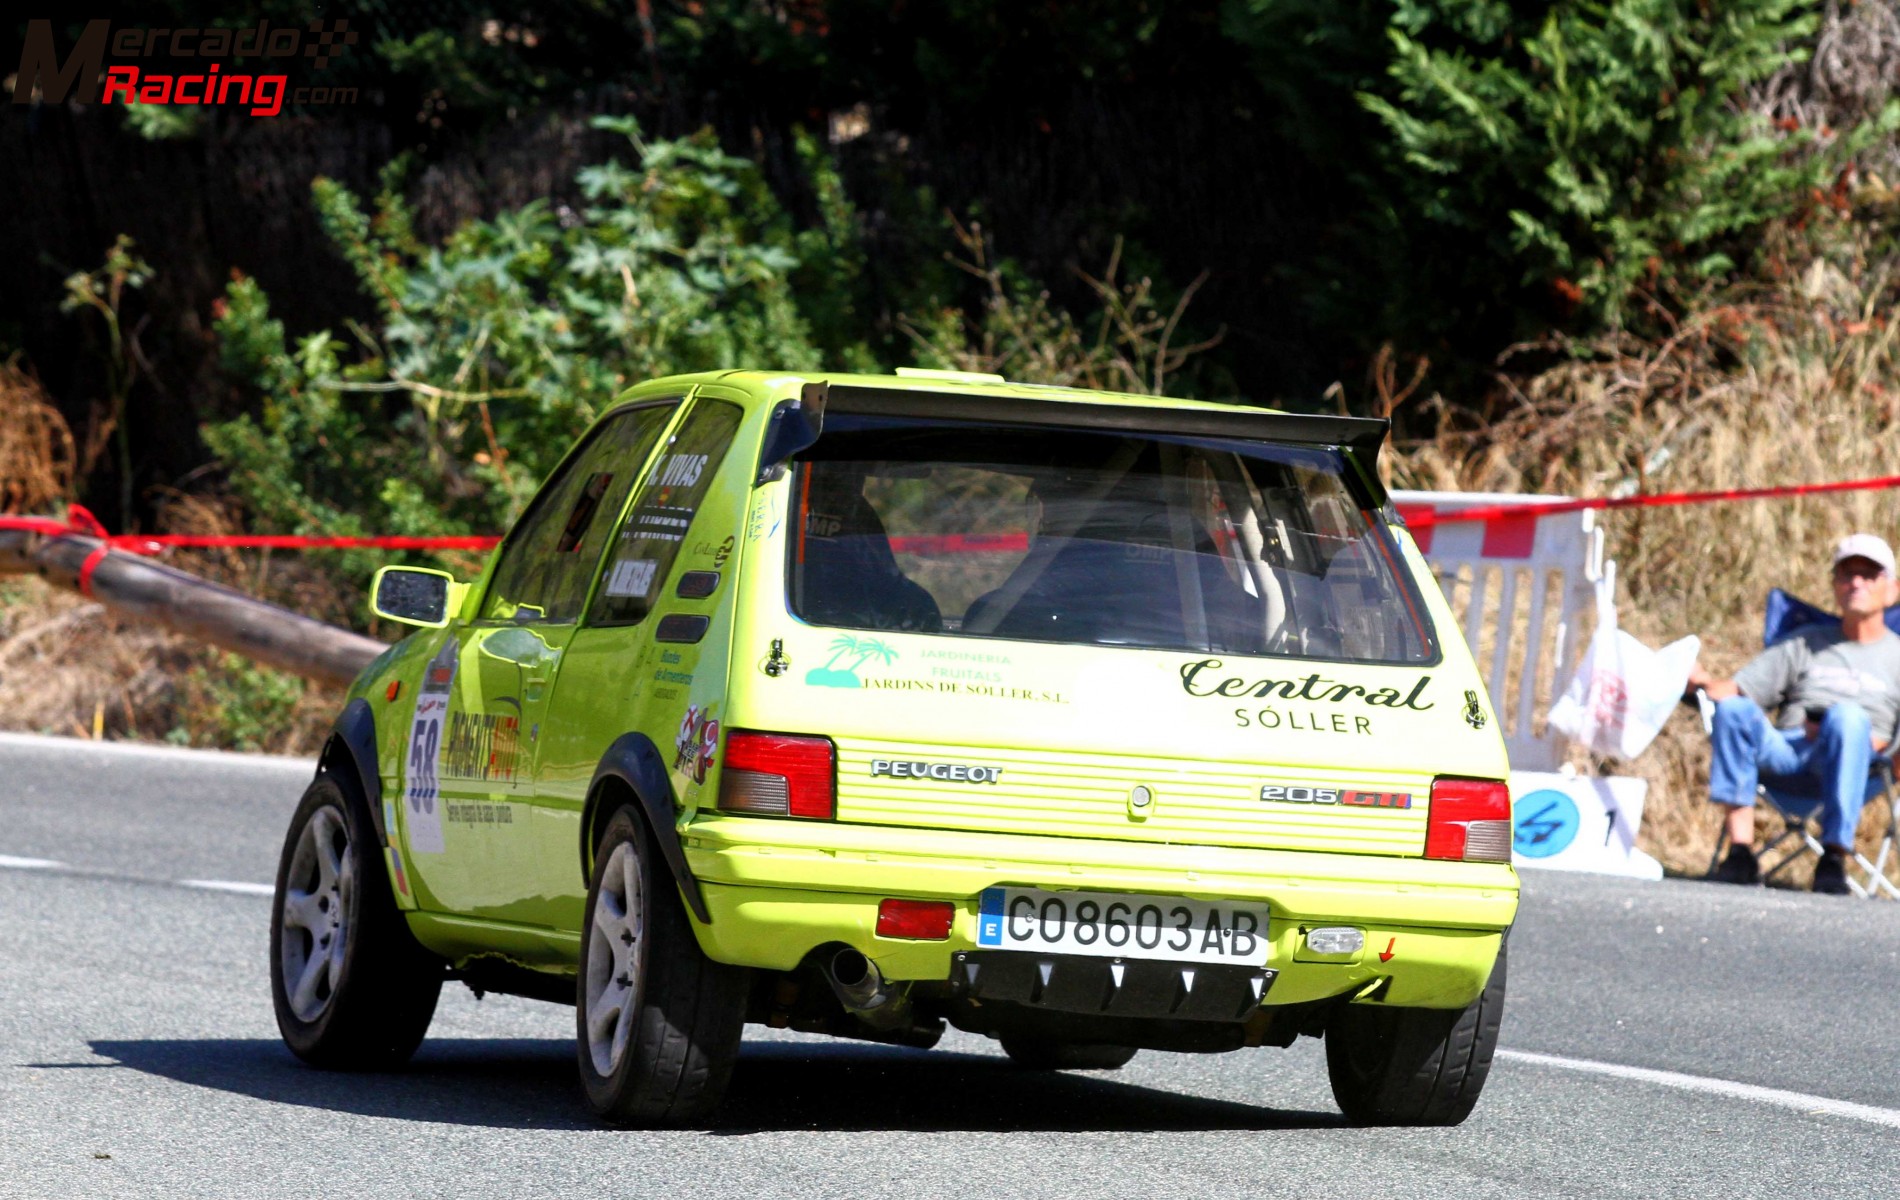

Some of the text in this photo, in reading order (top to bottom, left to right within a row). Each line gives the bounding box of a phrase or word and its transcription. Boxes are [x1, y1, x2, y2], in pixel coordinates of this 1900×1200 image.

[661, 454, 708, 487] VIVAS
[919, 647, 1013, 666] JARDINERIA
[861, 676, 935, 691] JARDINS
[938, 680, 963, 694] DE
[931, 666, 1003, 683] FRUITALS
[1179, 659, 1435, 711] Central
[1234, 704, 1373, 736] SÓLLER
[410, 718, 439, 815] 58
[871, 759, 1002, 785] PEUGEOT
[1261, 784, 1411, 809] 205 GTI
[985, 923, 997, 937] E
